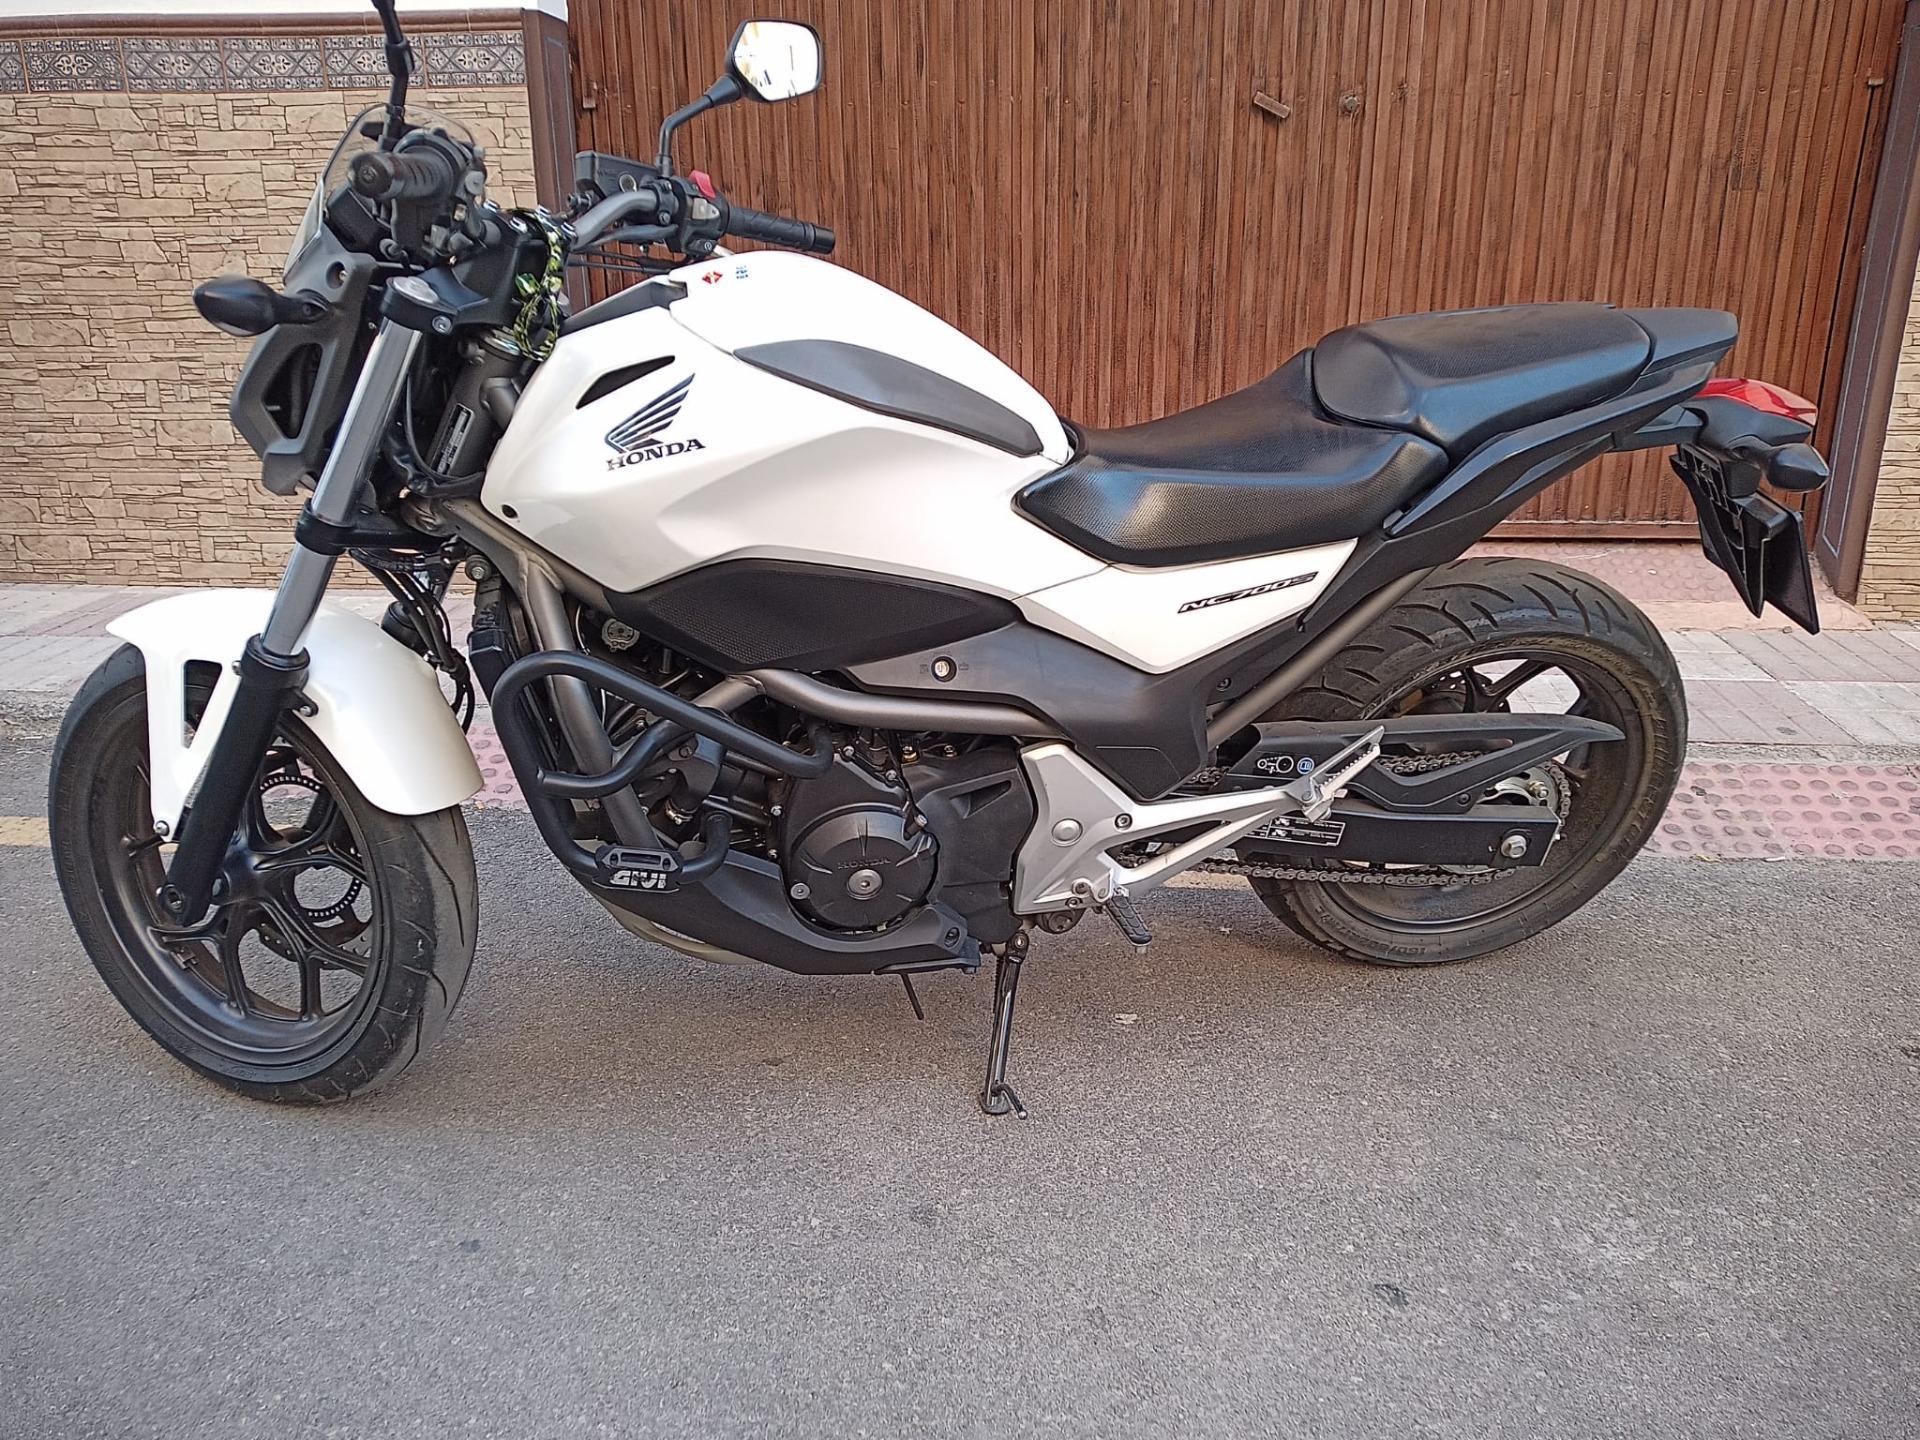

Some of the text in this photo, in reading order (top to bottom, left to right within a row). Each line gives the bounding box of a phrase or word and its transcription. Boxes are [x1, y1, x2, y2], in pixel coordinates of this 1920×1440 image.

[606, 438, 706, 471] HONDA
[1179, 573, 1317, 612] NC700S
[610, 870, 667, 889] GIVI
